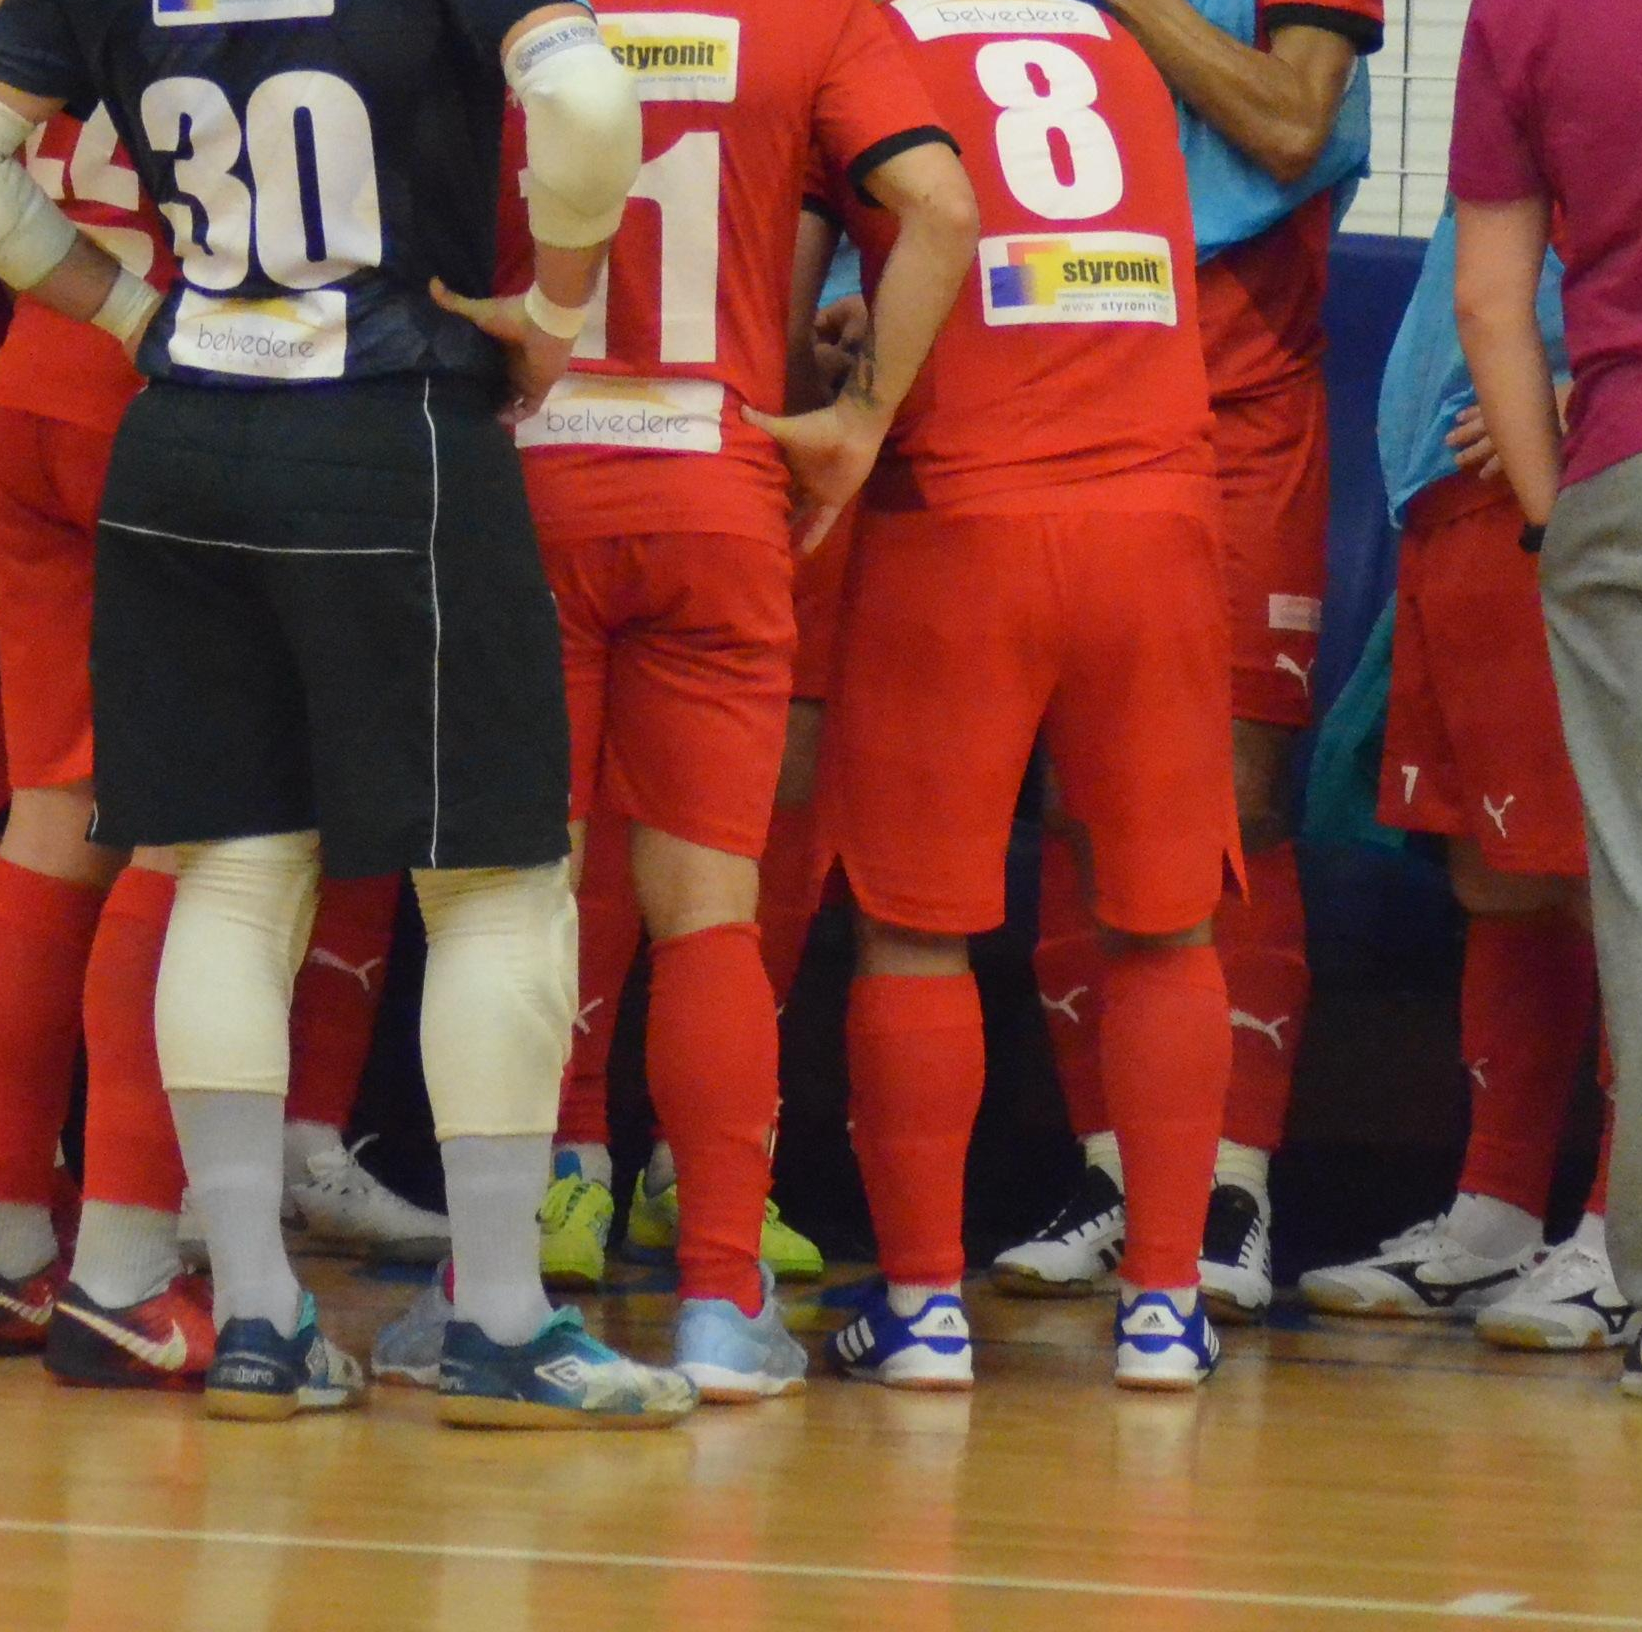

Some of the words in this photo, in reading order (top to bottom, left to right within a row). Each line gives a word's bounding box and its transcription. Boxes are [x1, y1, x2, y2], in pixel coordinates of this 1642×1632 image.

[936, 5, 1080, 24] belvedere
[611, 41, 716, 70] styronit
[974, 38, 1124, 220] 8
[140, 70, 383, 291] 30
[1062, 257, 1161, 285] styronit
[197, 323, 316, 359] belvedere
[546, 407, 690, 434] belvedere
